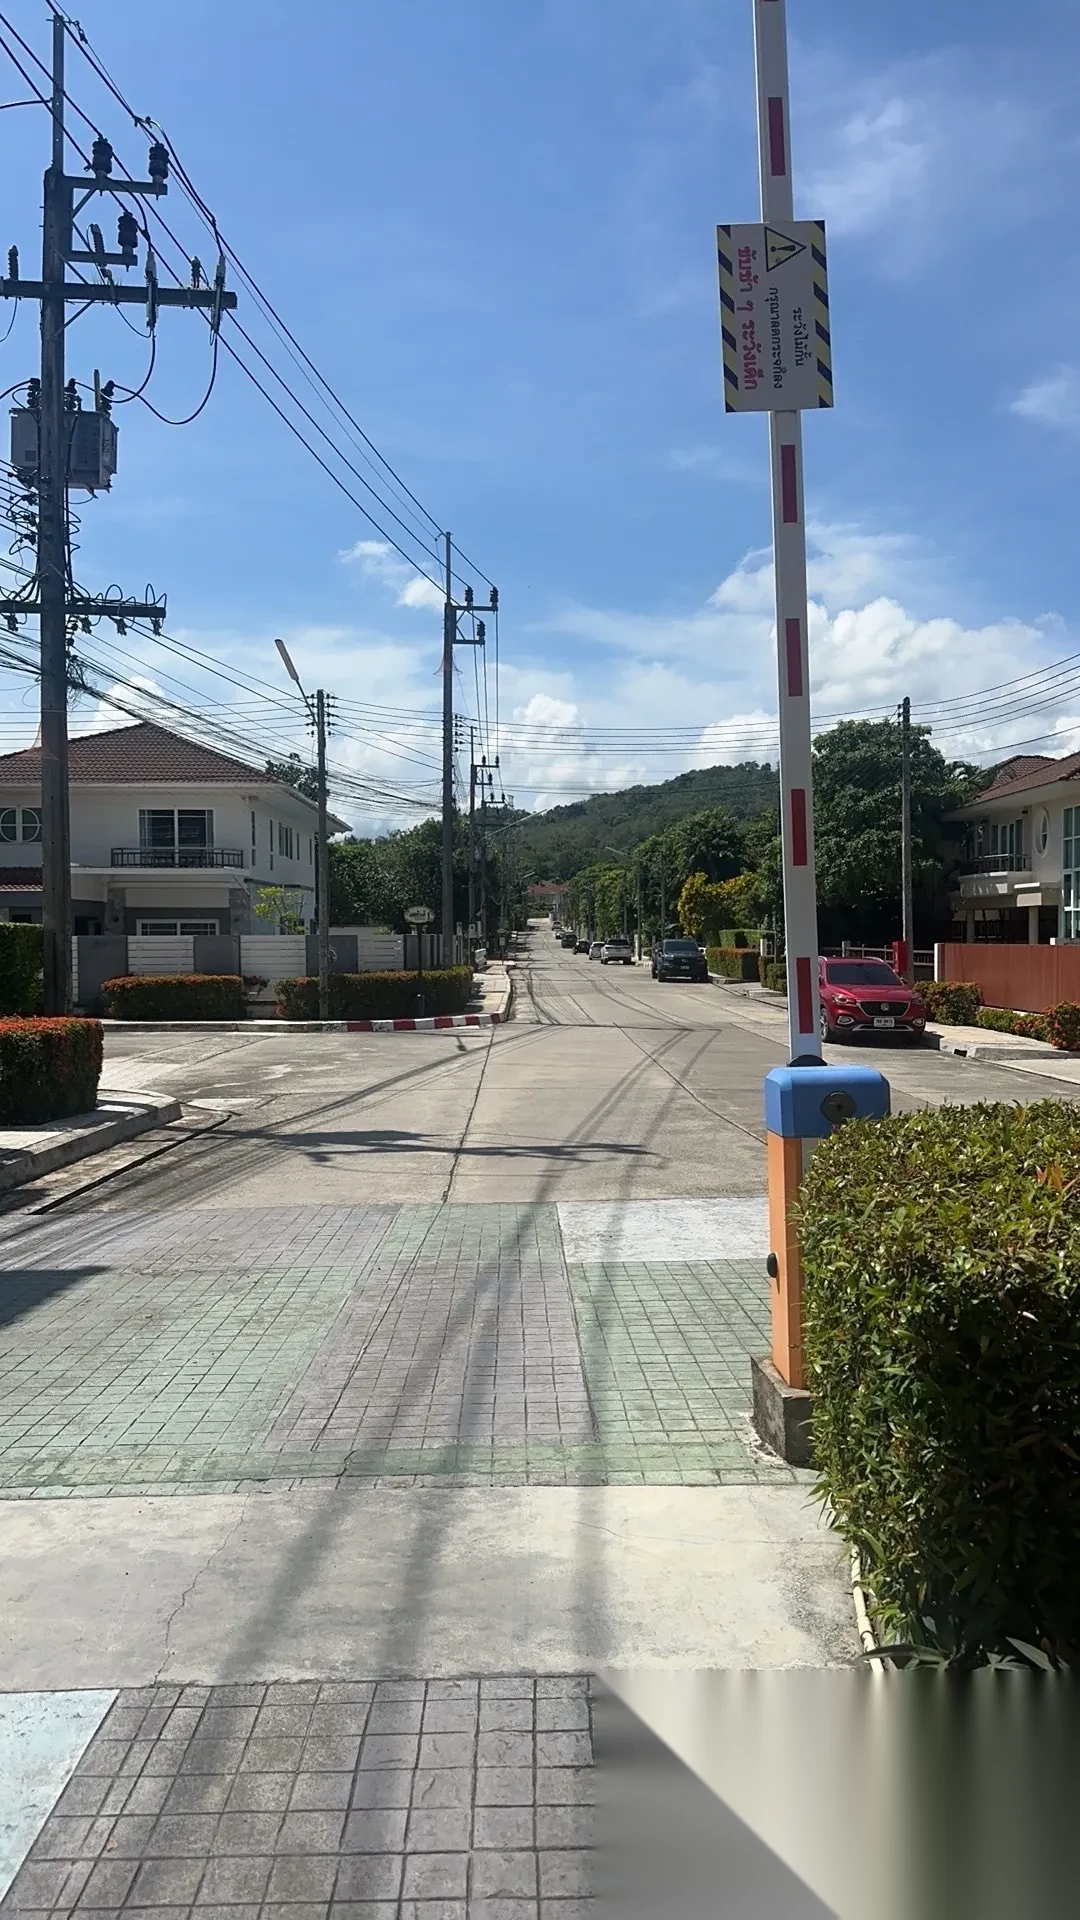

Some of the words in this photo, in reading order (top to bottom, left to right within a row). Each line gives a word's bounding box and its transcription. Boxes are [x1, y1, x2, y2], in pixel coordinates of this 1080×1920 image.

[738, 245, 759, 293] ขับช้า
[737, 300, 754, 312] ๆ
[741, 319, 764, 391] ระวังเด็ก
[765, 287, 785, 389] กรุณาลดกระจกลง
[792, 307, 812, 367] ระวังไม้กั้น
